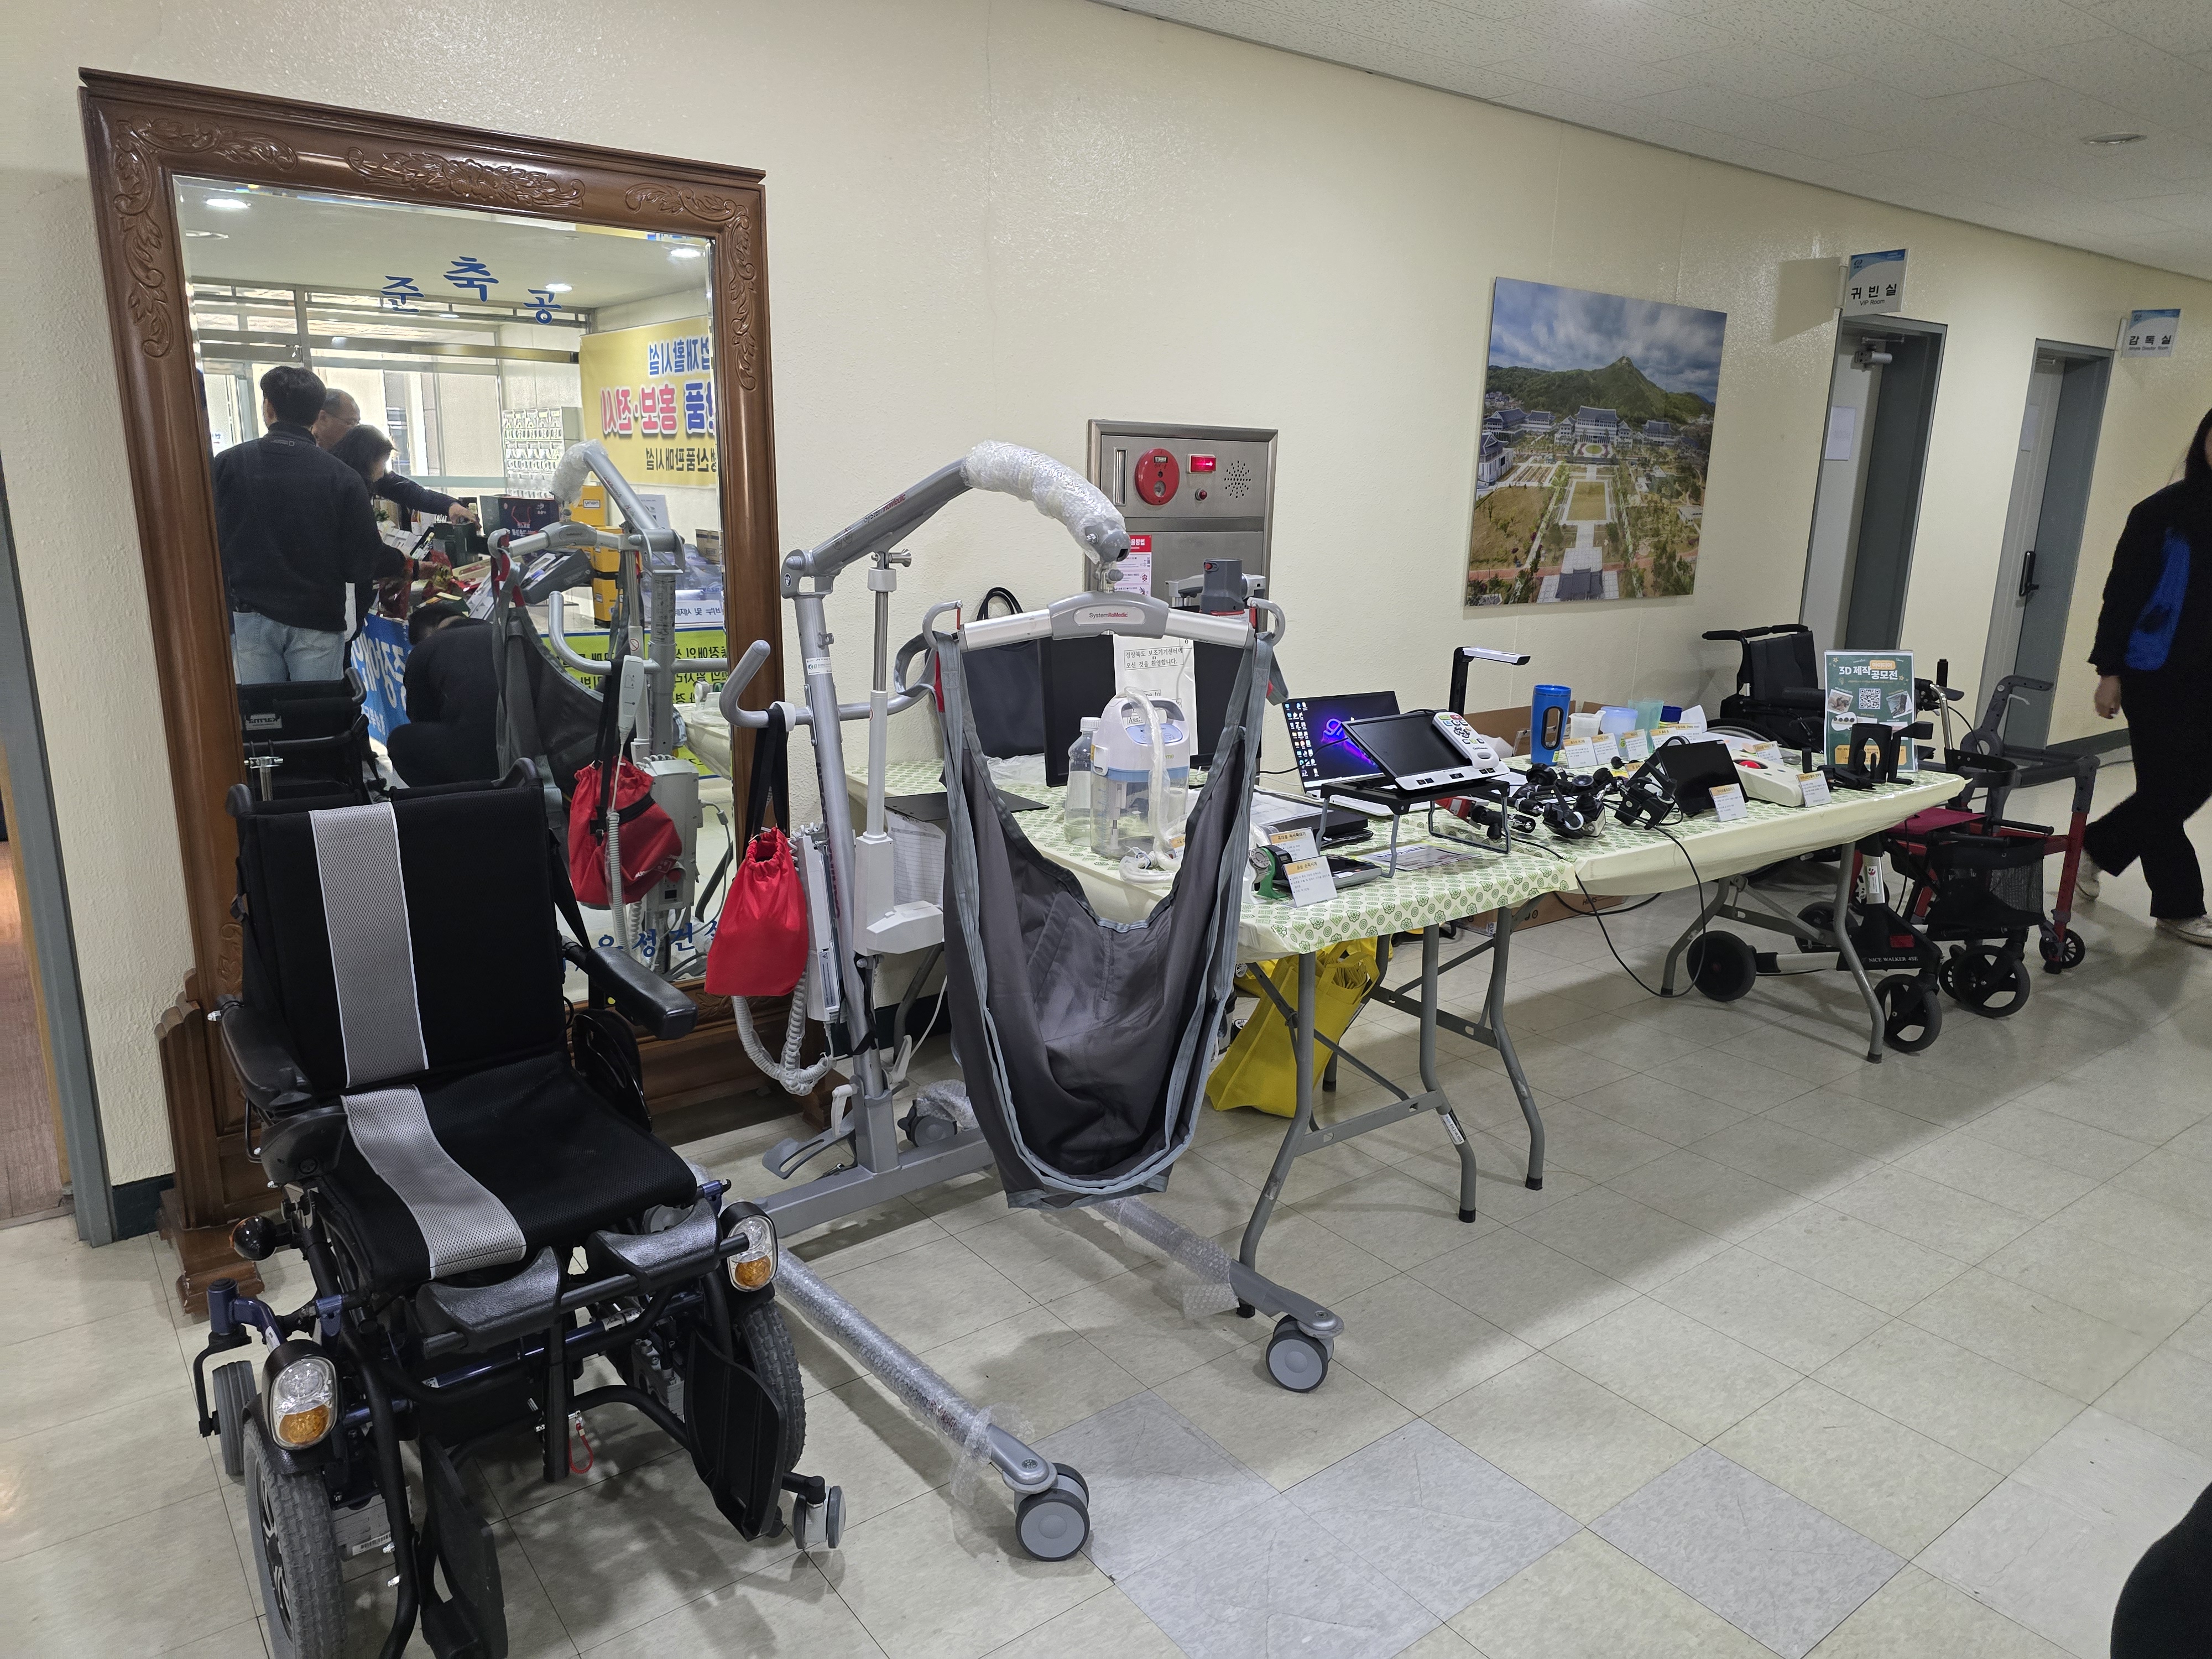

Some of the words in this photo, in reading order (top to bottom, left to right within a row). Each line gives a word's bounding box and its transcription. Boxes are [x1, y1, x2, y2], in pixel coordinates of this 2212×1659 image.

[380, 275, 425, 313] 준
[443, 256, 499, 302] 축
[523, 289, 562, 324] 공
[1839, 666, 1851, 675] 3D
[1853, 666, 1871, 675] 제작
[1871, 670, 1898, 680] 공모전
